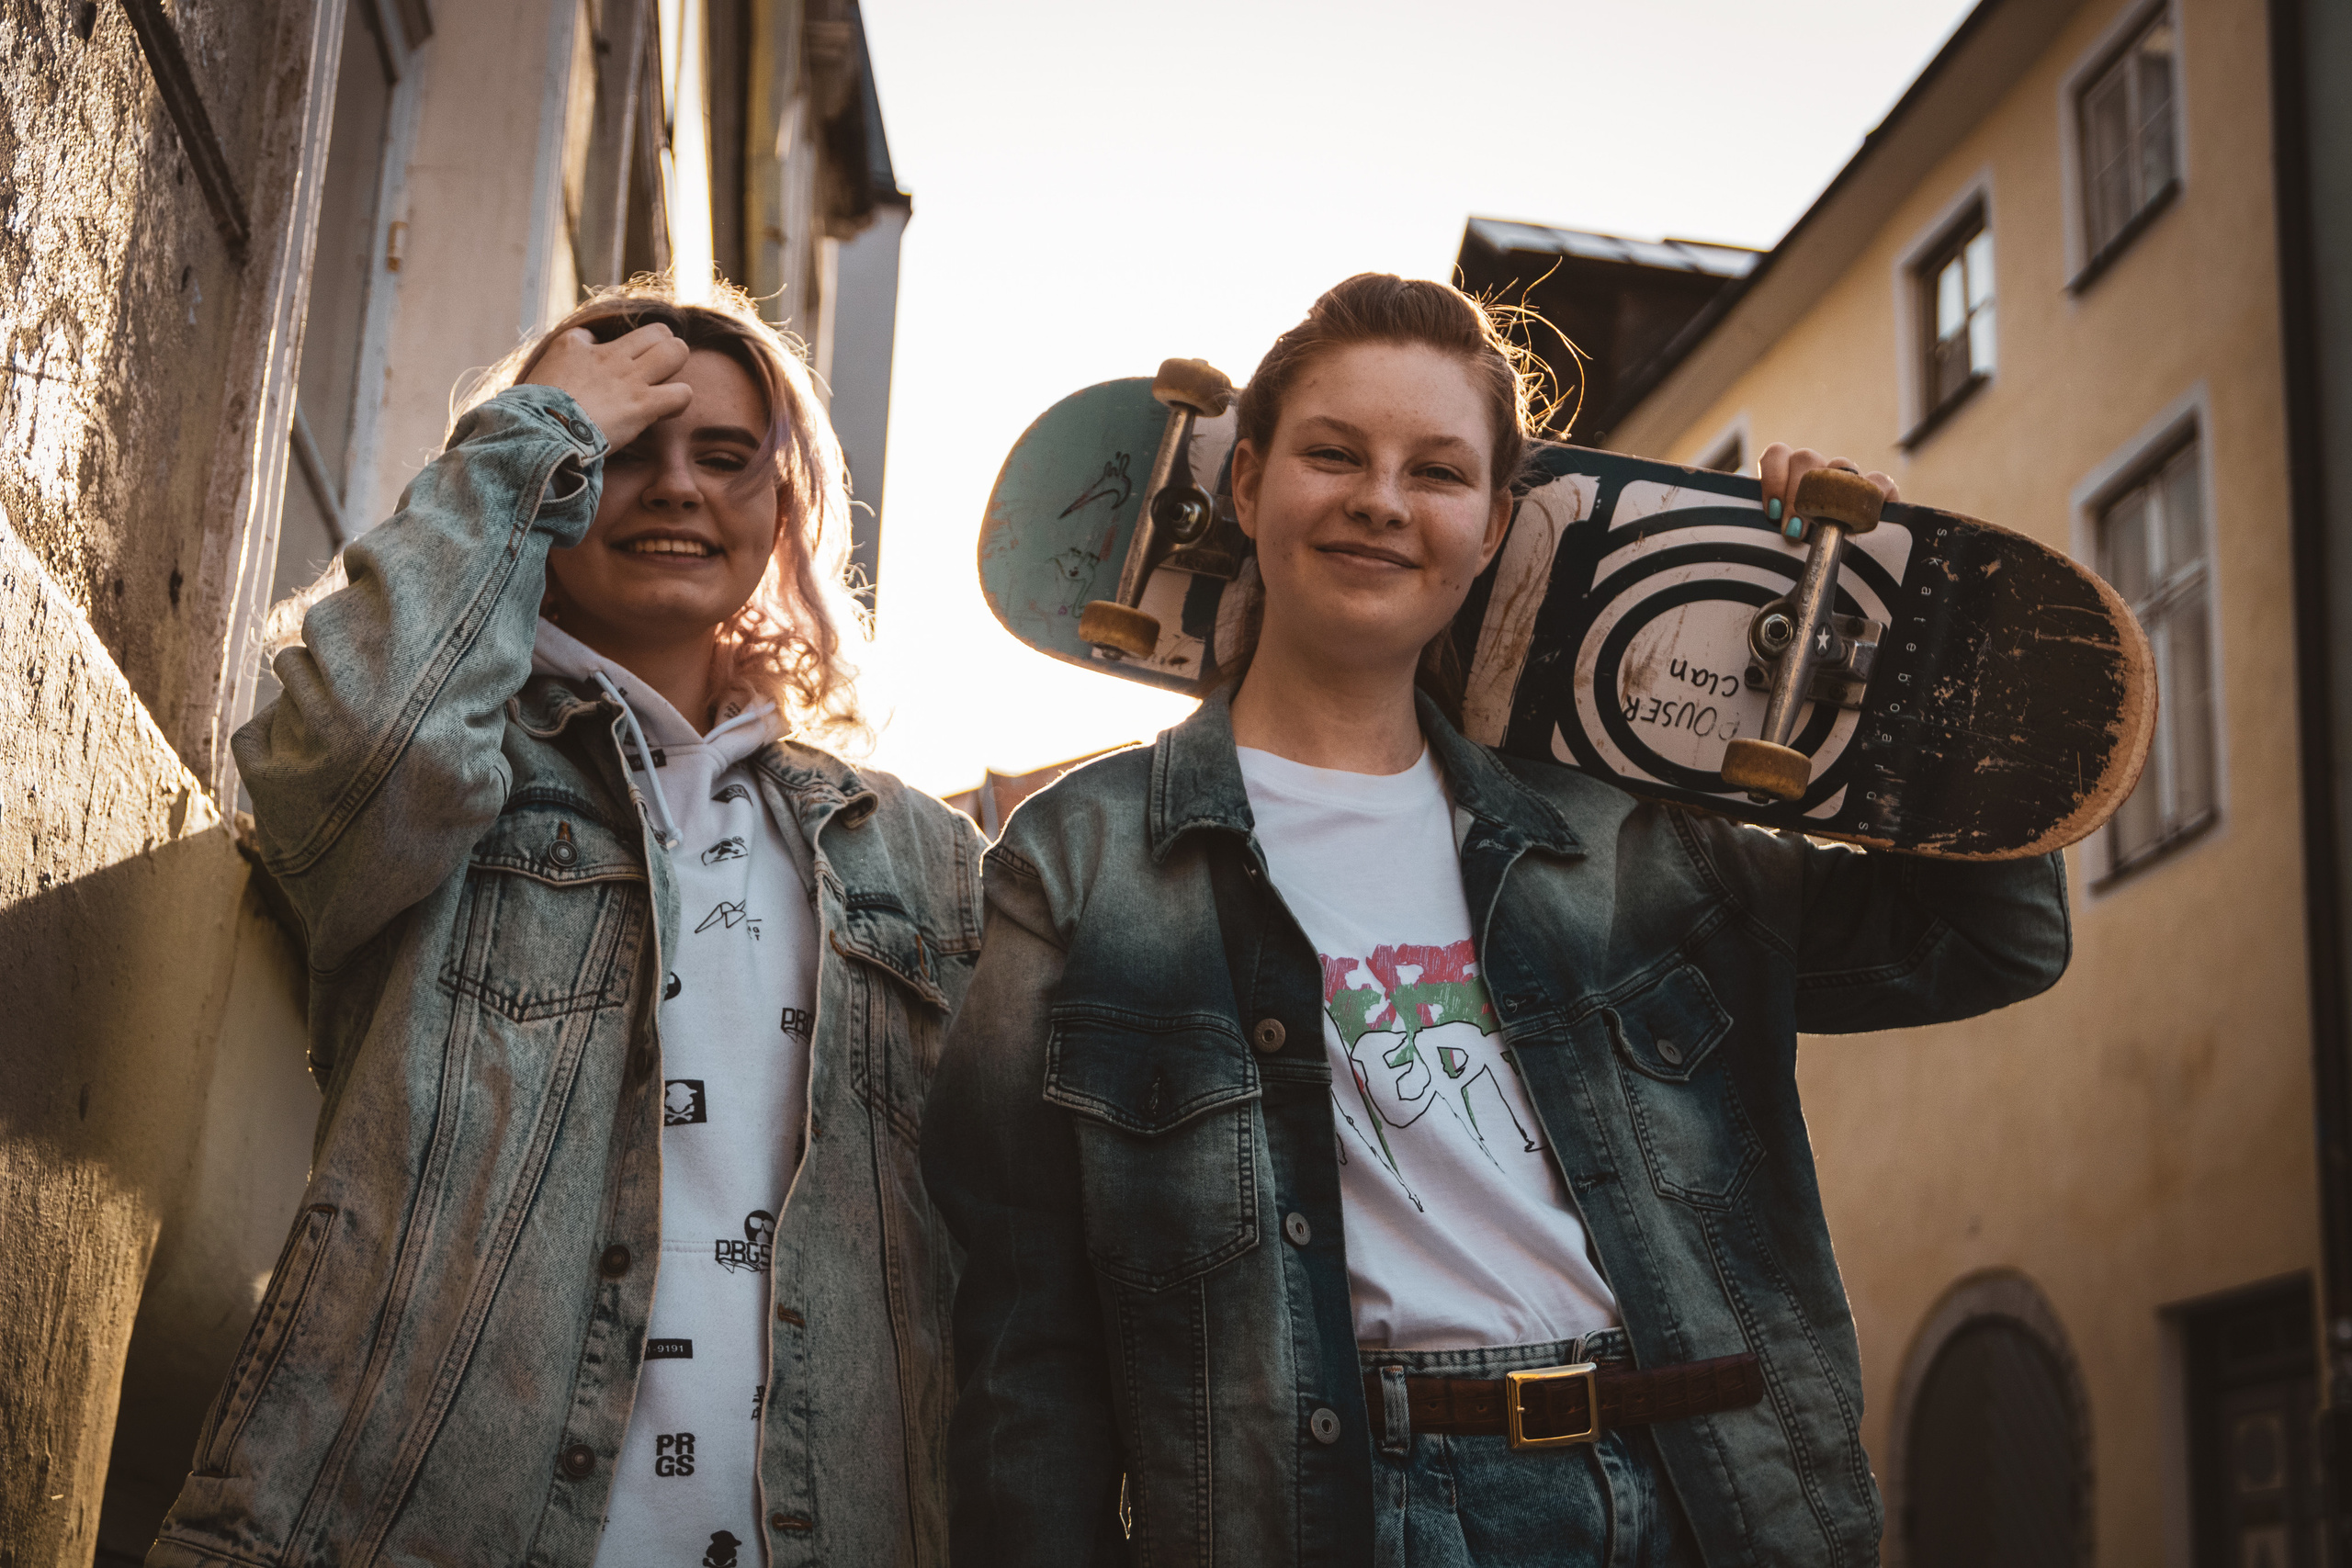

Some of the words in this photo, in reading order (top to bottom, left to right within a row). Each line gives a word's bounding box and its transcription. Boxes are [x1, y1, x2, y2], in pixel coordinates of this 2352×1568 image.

[715, 1239, 773, 1269] PRGS
[656, 1433, 695, 1456] PR
[655, 1455, 695, 1477] GS
